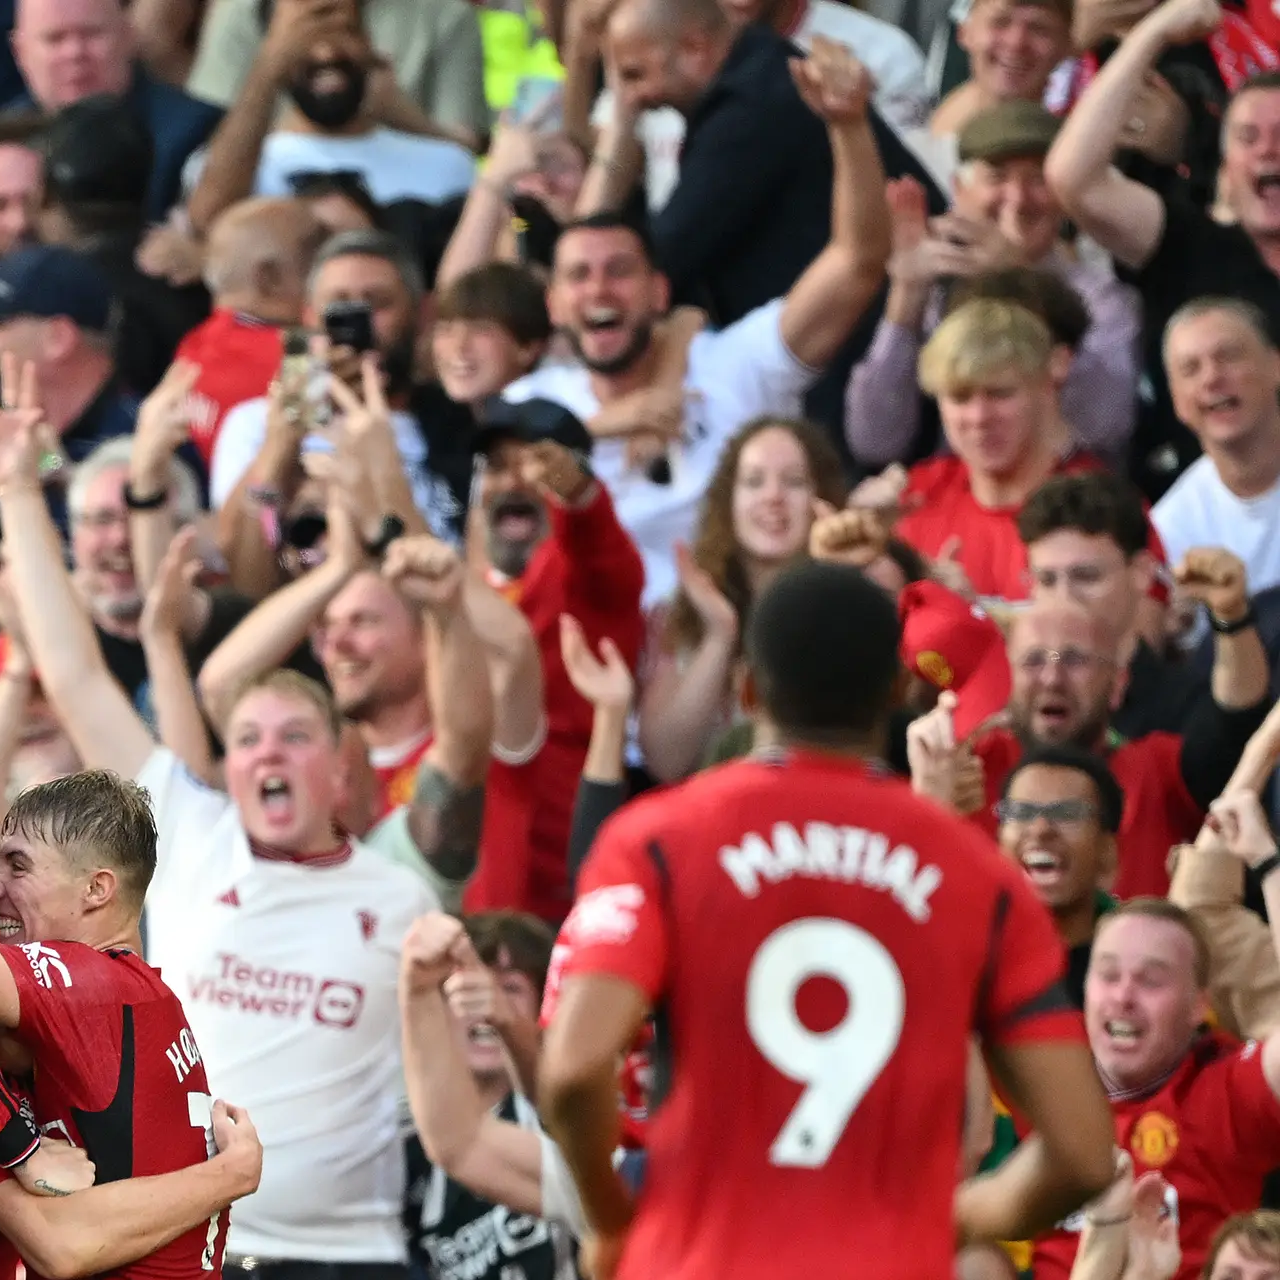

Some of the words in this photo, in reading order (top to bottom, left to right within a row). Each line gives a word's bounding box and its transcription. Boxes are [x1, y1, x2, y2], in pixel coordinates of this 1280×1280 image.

[718, 820, 943, 924] MARTIAL
[186, 971, 308, 1019] Viewer
[217, 951, 314, 994] Team
[745, 915, 907, 1169] 9
